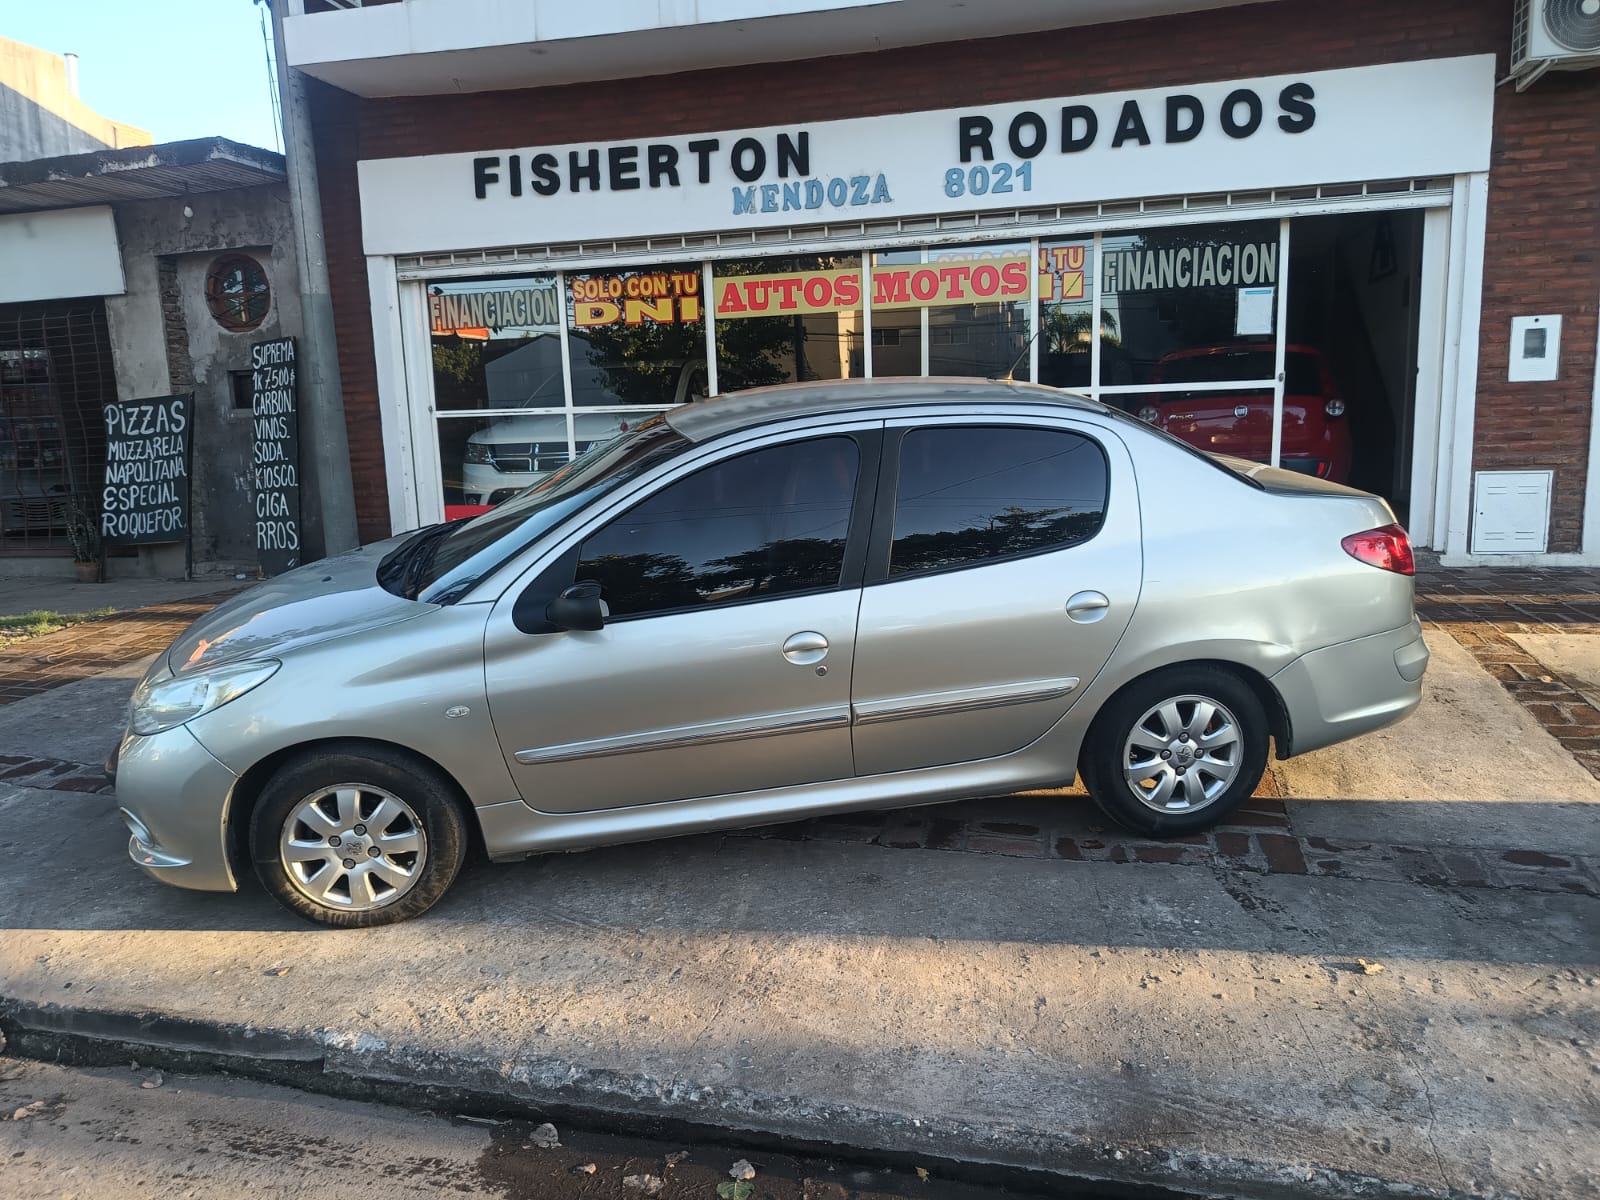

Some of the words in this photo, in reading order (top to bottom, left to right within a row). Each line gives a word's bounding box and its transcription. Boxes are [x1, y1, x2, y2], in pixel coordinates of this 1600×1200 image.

[473, 131, 810, 199] FISHERTON
[958, 82, 1316, 162] RODADOS
[732, 173, 893, 215] MENDOZA
[944, 161, 1033, 198] 8021
[1053, 246, 1086, 270] TU
[1101, 242, 1277, 294] FINANCIACION
[572, 277, 623, 301] SOLO
[625, 273, 669, 298] CON
[670, 271, 699, 296] TU
[718, 274, 860, 313] AUTOS
[873, 261, 1028, 304] MOTOS
[430, 288, 560, 332] FINANCIACION
[574, 296, 700, 326] DNI
[252, 340, 295, 370] SUPREMA
[104, 400, 186, 436] PIZZAS
[107, 434, 184, 461] MUZZARELA
[105, 456, 187, 485] NAPOLITANA
[103, 480, 179, 510] ESPECIAL
[256, 490, 290, 518] CIGA
